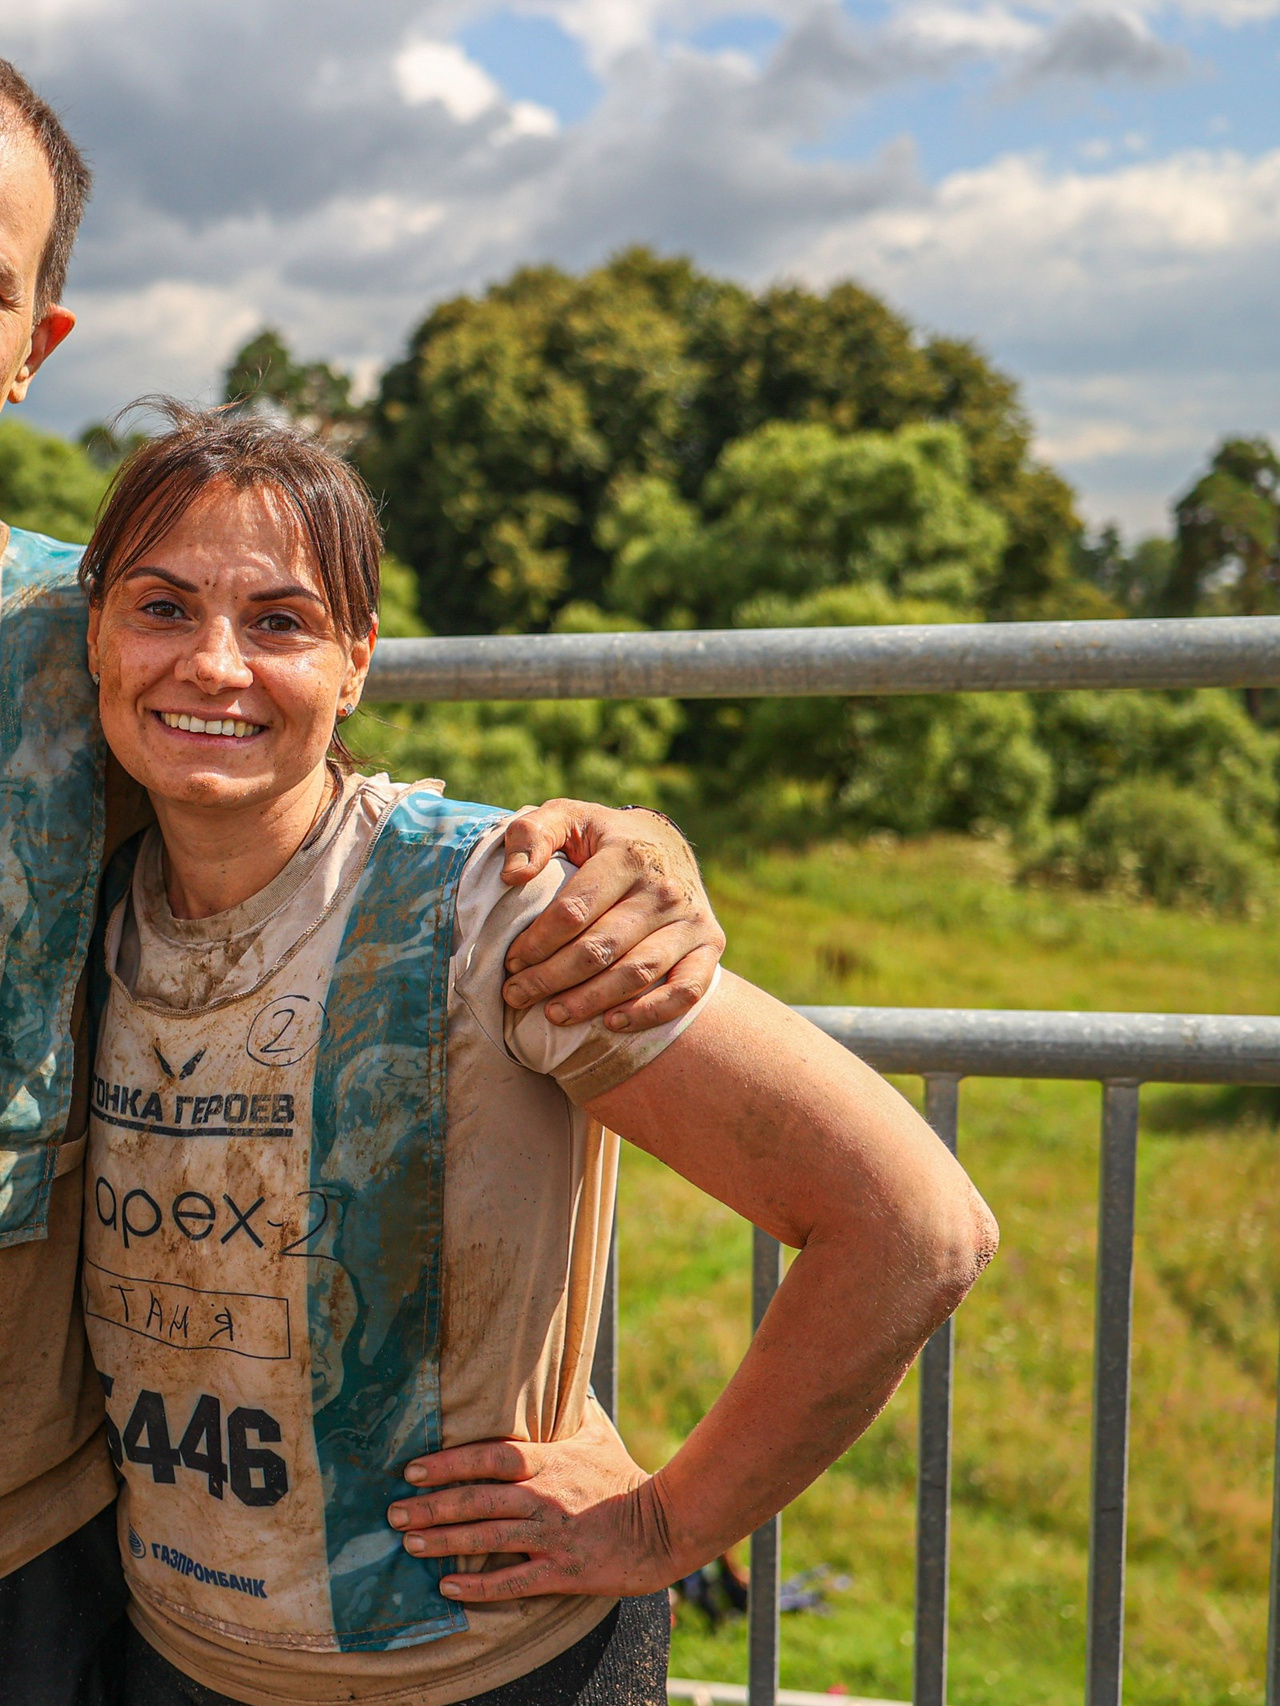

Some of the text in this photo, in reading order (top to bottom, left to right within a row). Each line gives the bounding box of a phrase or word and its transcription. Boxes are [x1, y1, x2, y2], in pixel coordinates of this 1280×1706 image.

[260, 1008, 296, 1053] 2
[173, 1093, 295, 1125] ГЕРОЕВ
[95, 1176, 266, 1249] apex
[151, 1542, 268, 1599] ГАЗПРОМБАНК
